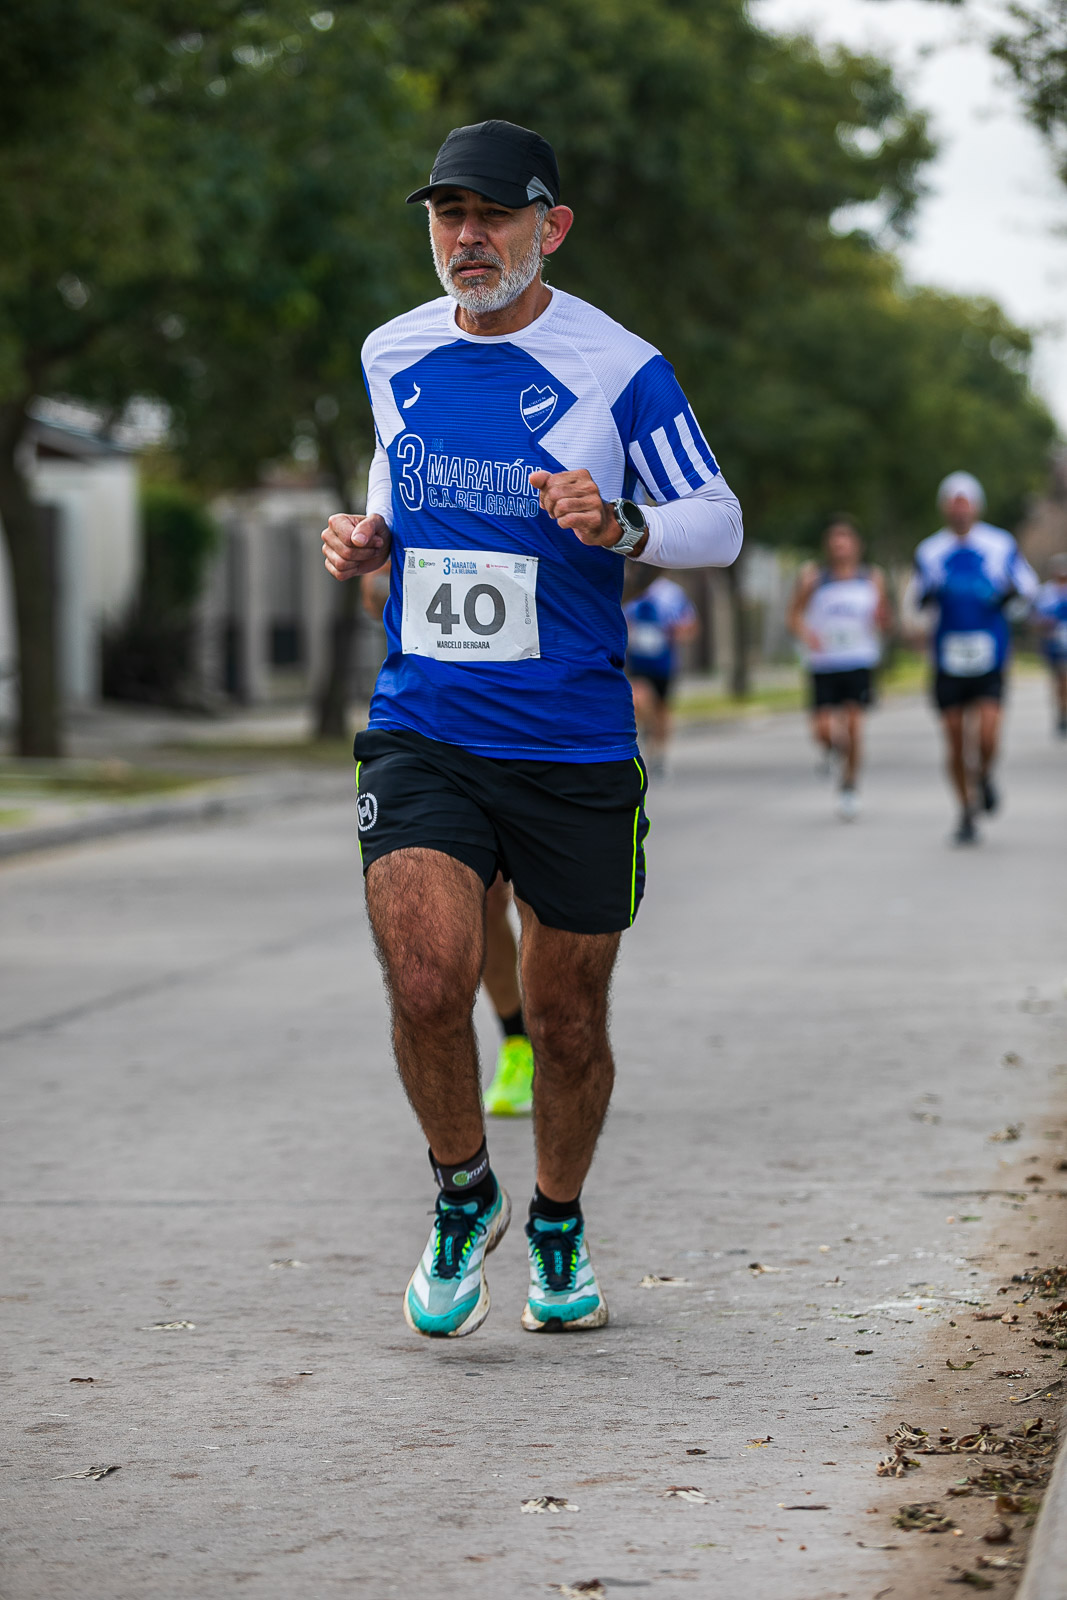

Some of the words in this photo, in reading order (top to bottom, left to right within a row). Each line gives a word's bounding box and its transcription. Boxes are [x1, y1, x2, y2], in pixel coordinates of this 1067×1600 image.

[397, 434, 425, 511] 3
[427, 454, 541, 498] MARATÓN
[443, 556, 451, 575] 3
[451, 561, 477, 569] MARATÓN
[425, 583, 506, 636] 40
[436, 640, 462, 649] MARCELO
[463, 640, 491, 650] BERGARA
